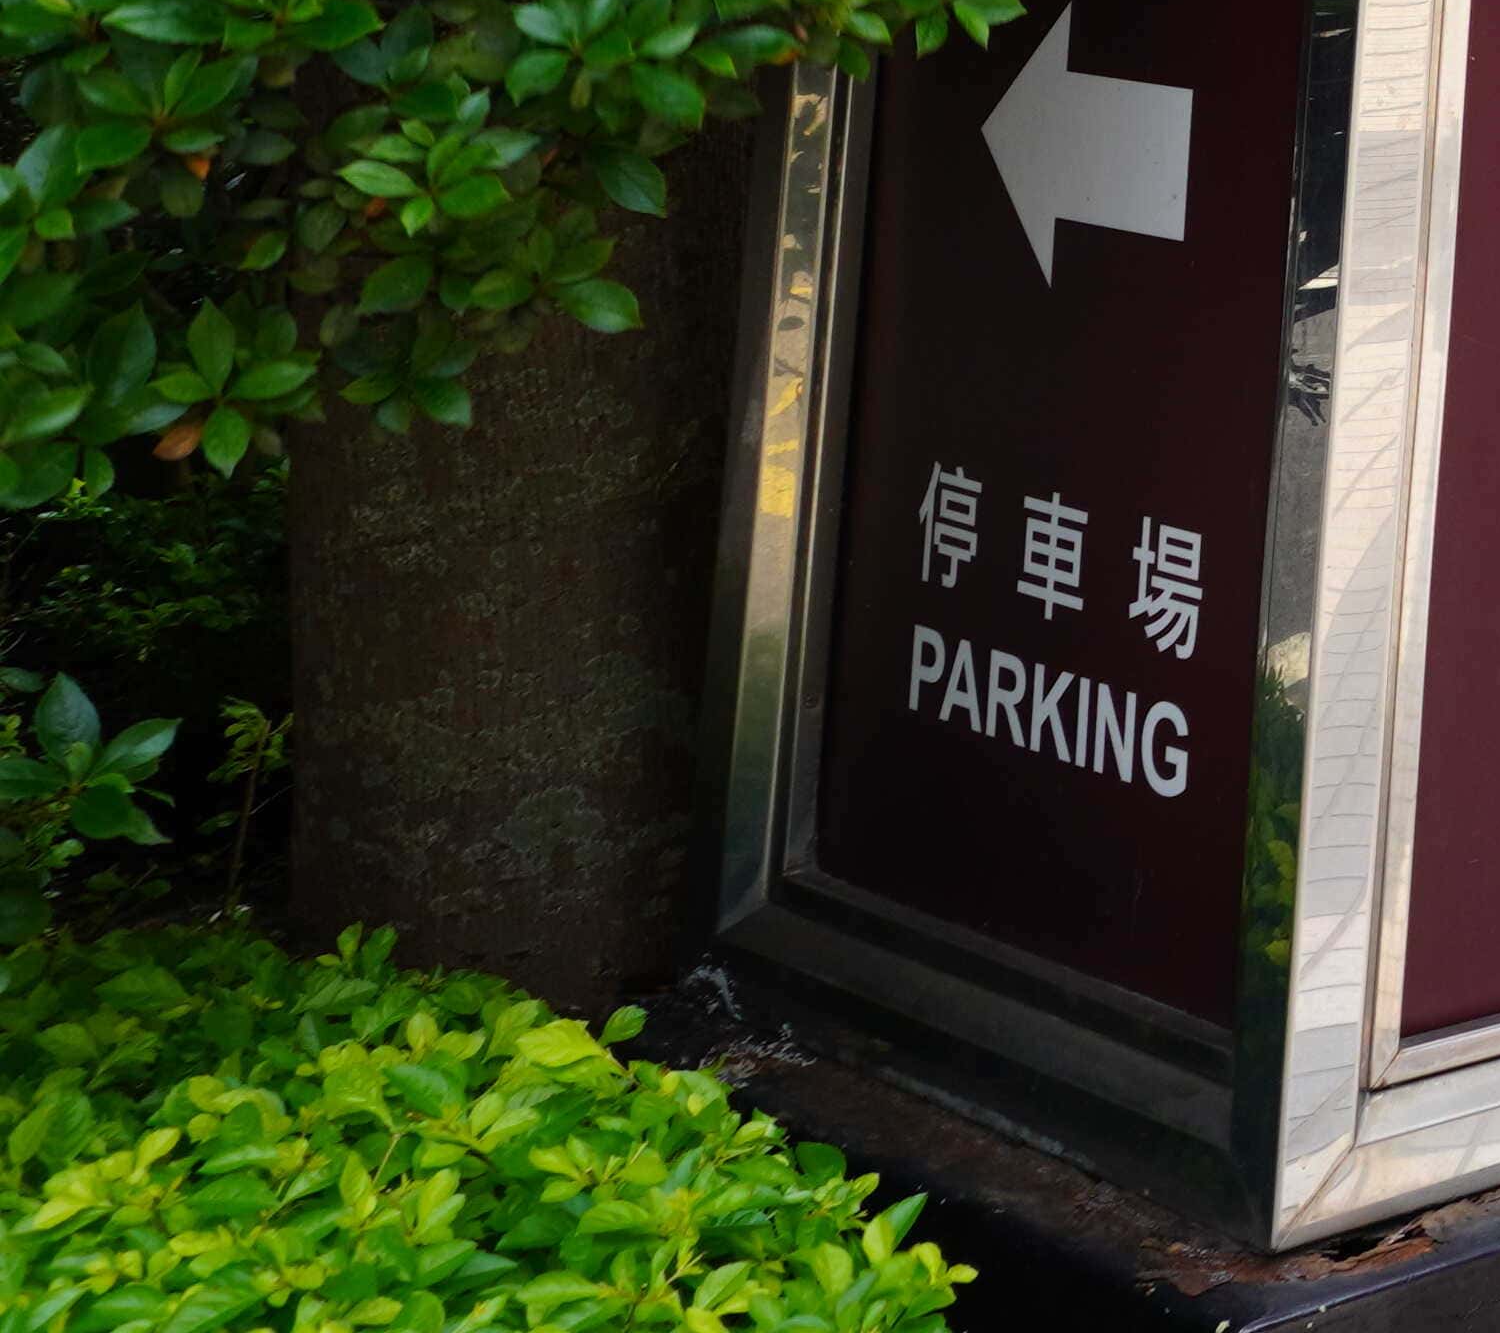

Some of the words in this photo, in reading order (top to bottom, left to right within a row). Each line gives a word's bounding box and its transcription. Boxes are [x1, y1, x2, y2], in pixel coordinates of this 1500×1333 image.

[919, 461, 1202, 660] 停車場
[909, 624, 1189, 798] PARKING
